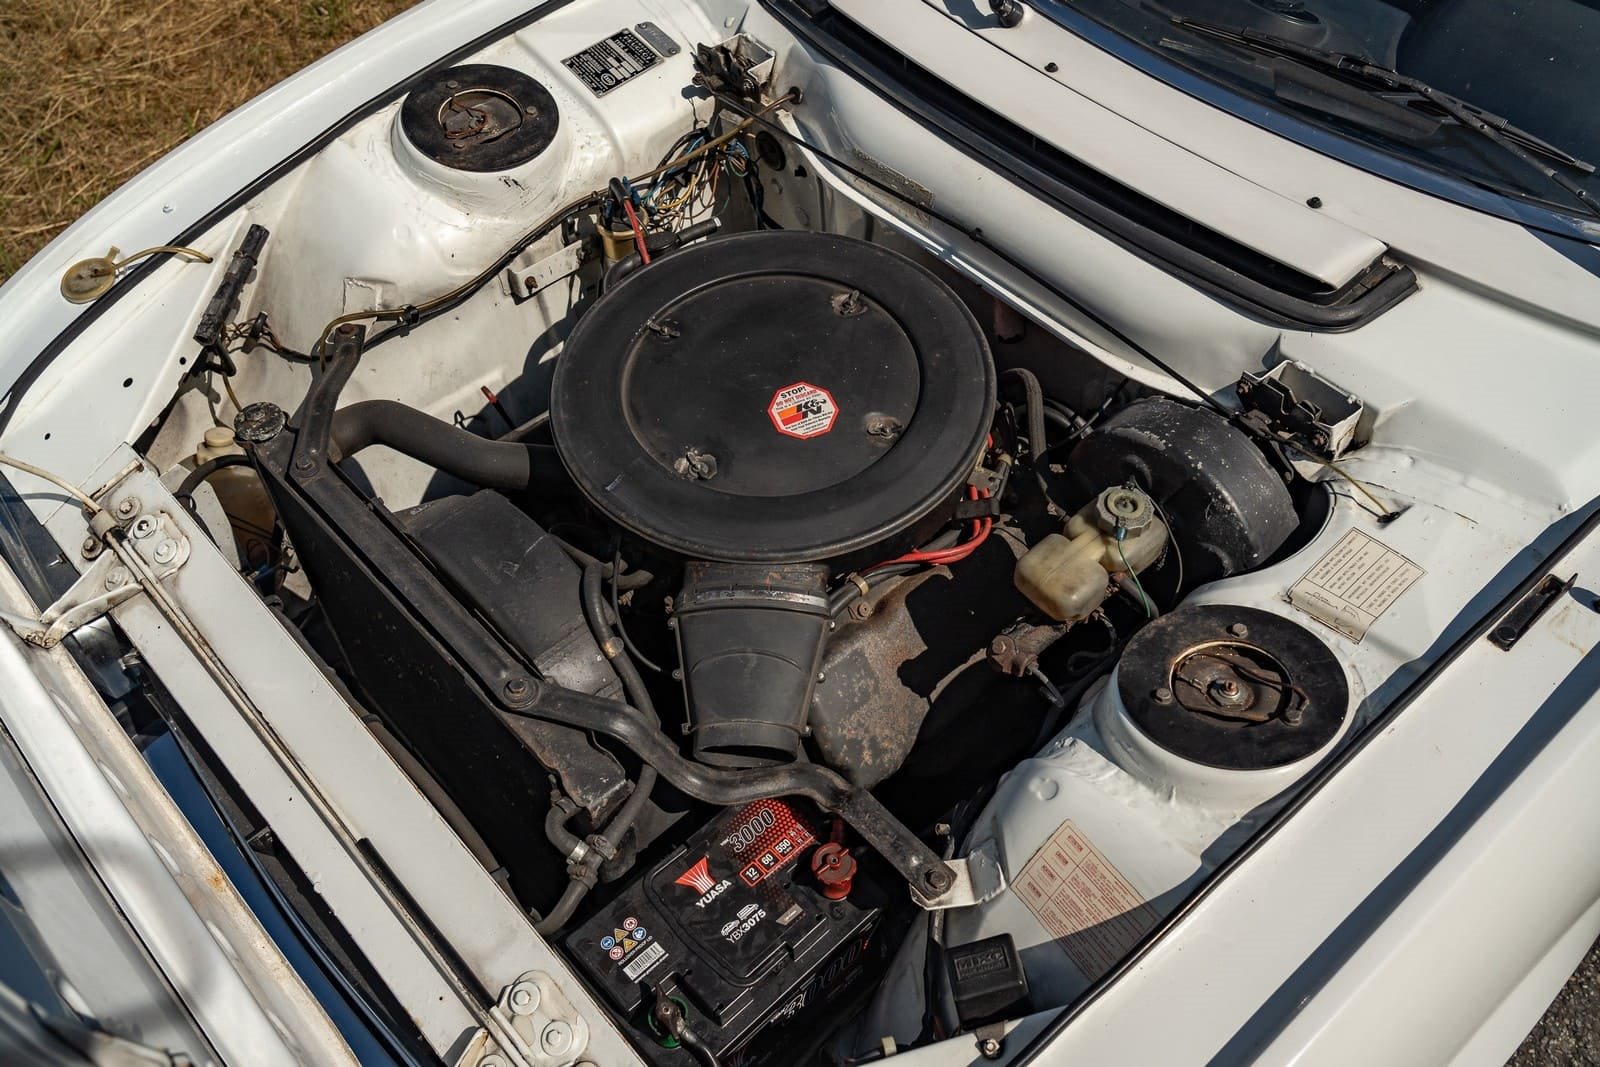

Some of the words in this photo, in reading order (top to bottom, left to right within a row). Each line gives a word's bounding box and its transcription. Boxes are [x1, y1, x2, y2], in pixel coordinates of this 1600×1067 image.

[623, 35, 650, 60] PEUGEOT
[780, 386, 806, 398] STOP!
[783, 397, 794, 405] NOT
[796, 398, 827, 419] K&N
[729, 807, 775, 853] 3000
[745, 867, 758, 878] 12
[761, 853, 774, 865] 60
[774, 838, 791, 854] 550
[695, 879, 733, 909] YUASA
[726, 908, 767, 944] YBX3075
